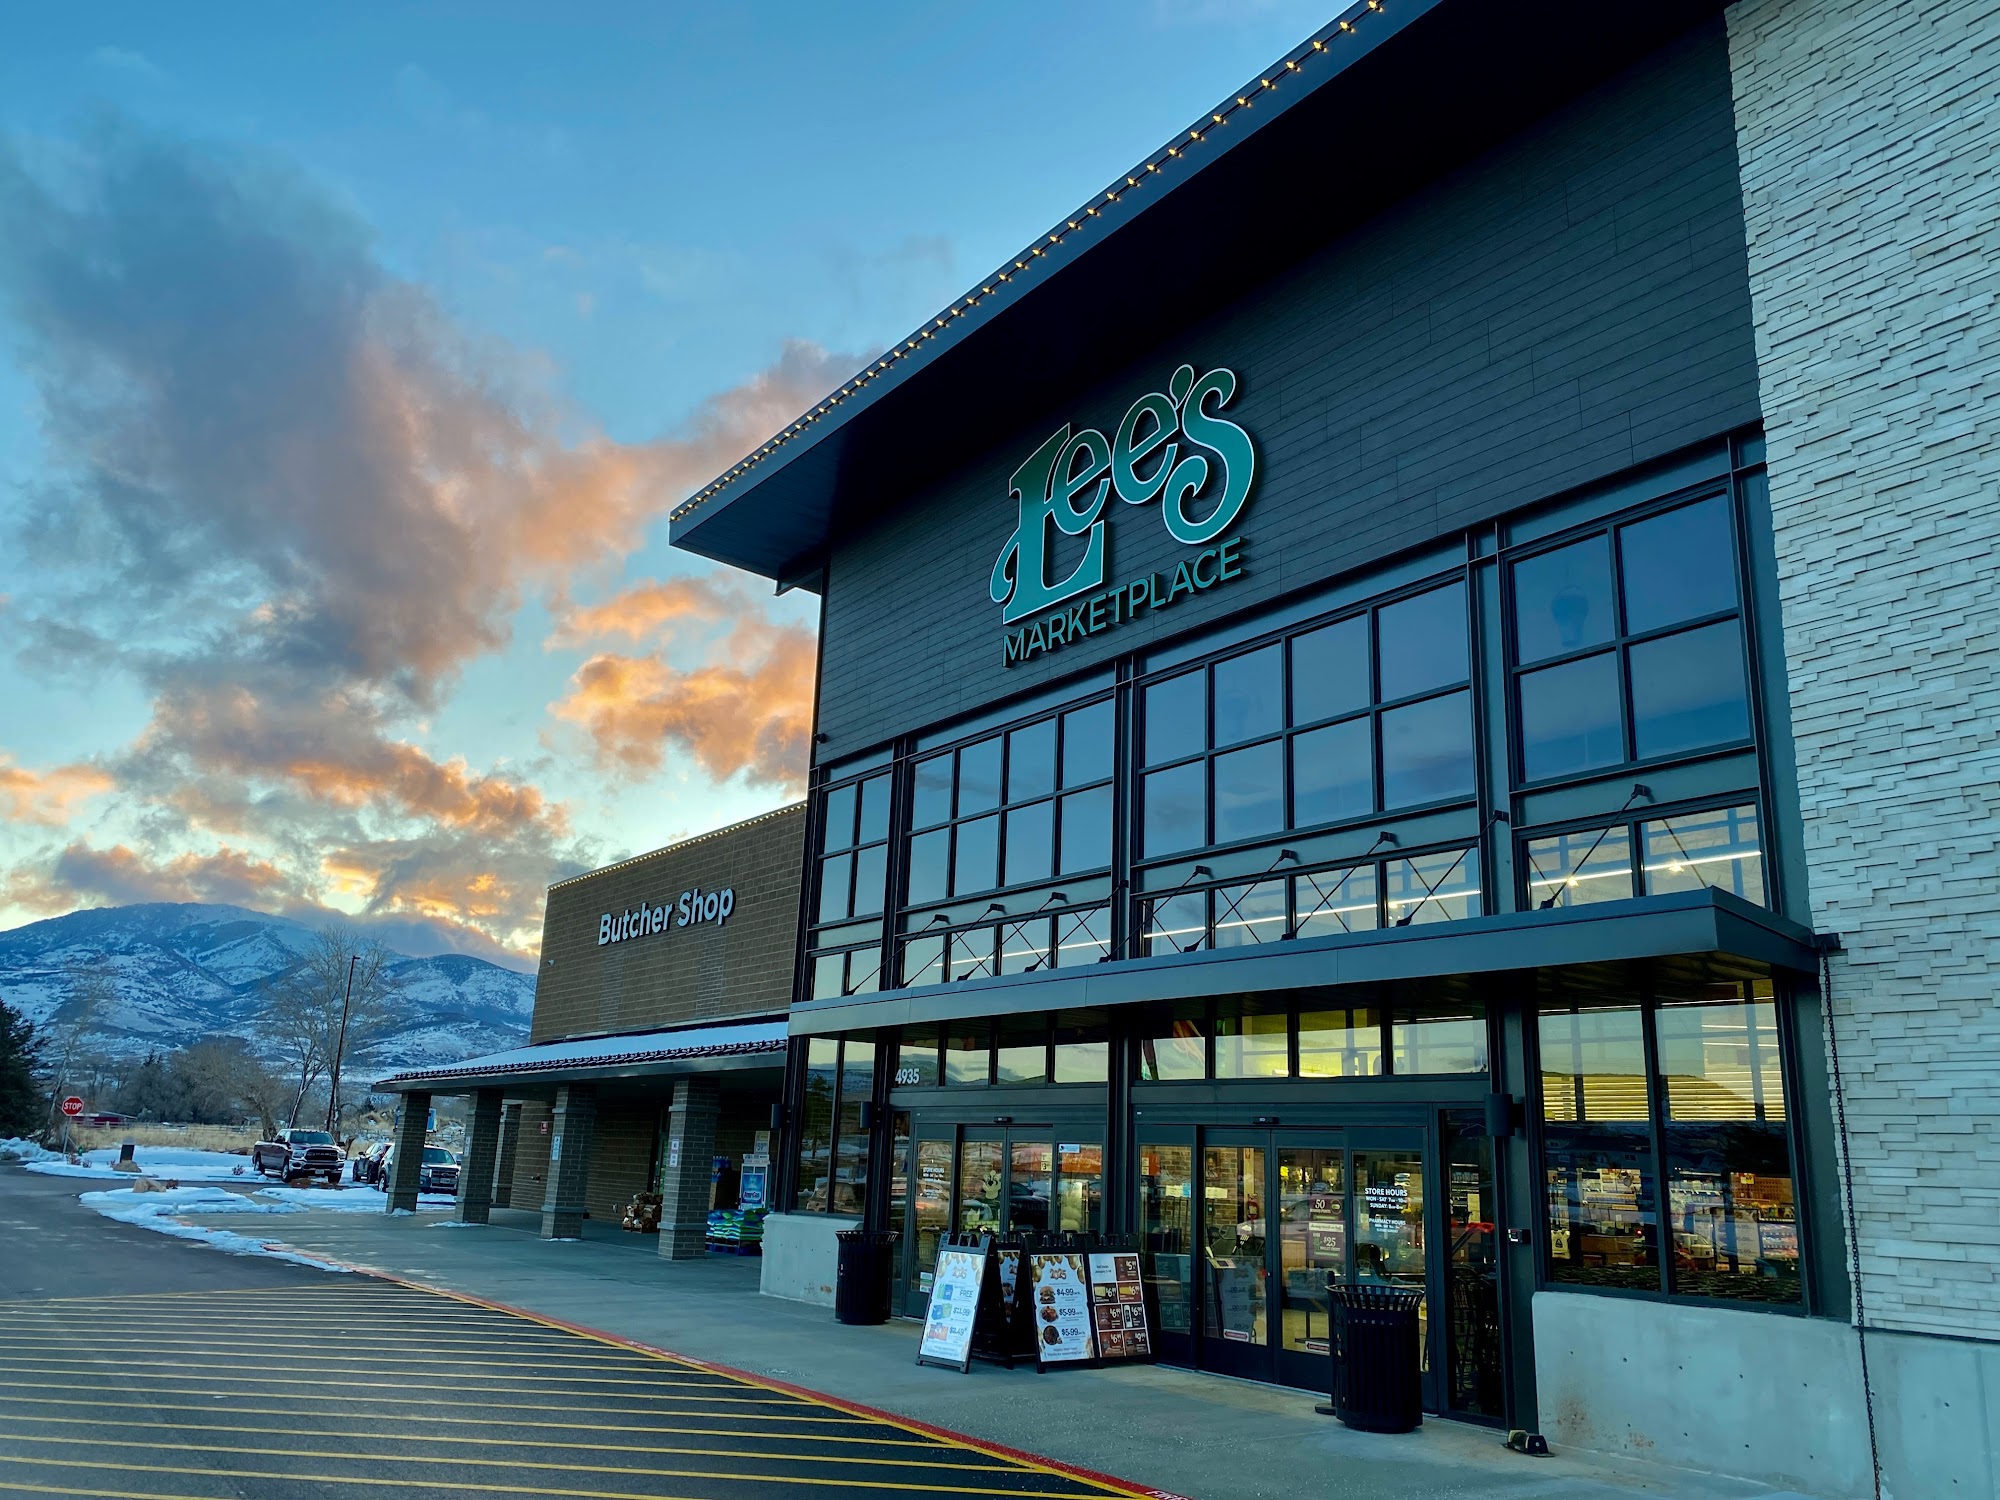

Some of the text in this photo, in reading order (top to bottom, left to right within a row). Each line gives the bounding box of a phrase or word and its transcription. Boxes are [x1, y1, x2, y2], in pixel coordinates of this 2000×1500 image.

[990, 364, 1254, 625] Lee's
[1002, 536, 1244, 667] MARKETPLACE
[598, 888, 735, 946] Butcher Shop
[895, 1068, 920, 1085] 4935
[63, 1102, 82, 1110] STOP
[1365, 1187, 1408, 1197] STORE HOURS
[1315, 1199, 1326, 1209] 50
[1323, 1236, 1337, 1247] $25
[1050, 1268, 1067, 1280] 2025
[960, 1289, 974, 1298] FREE
